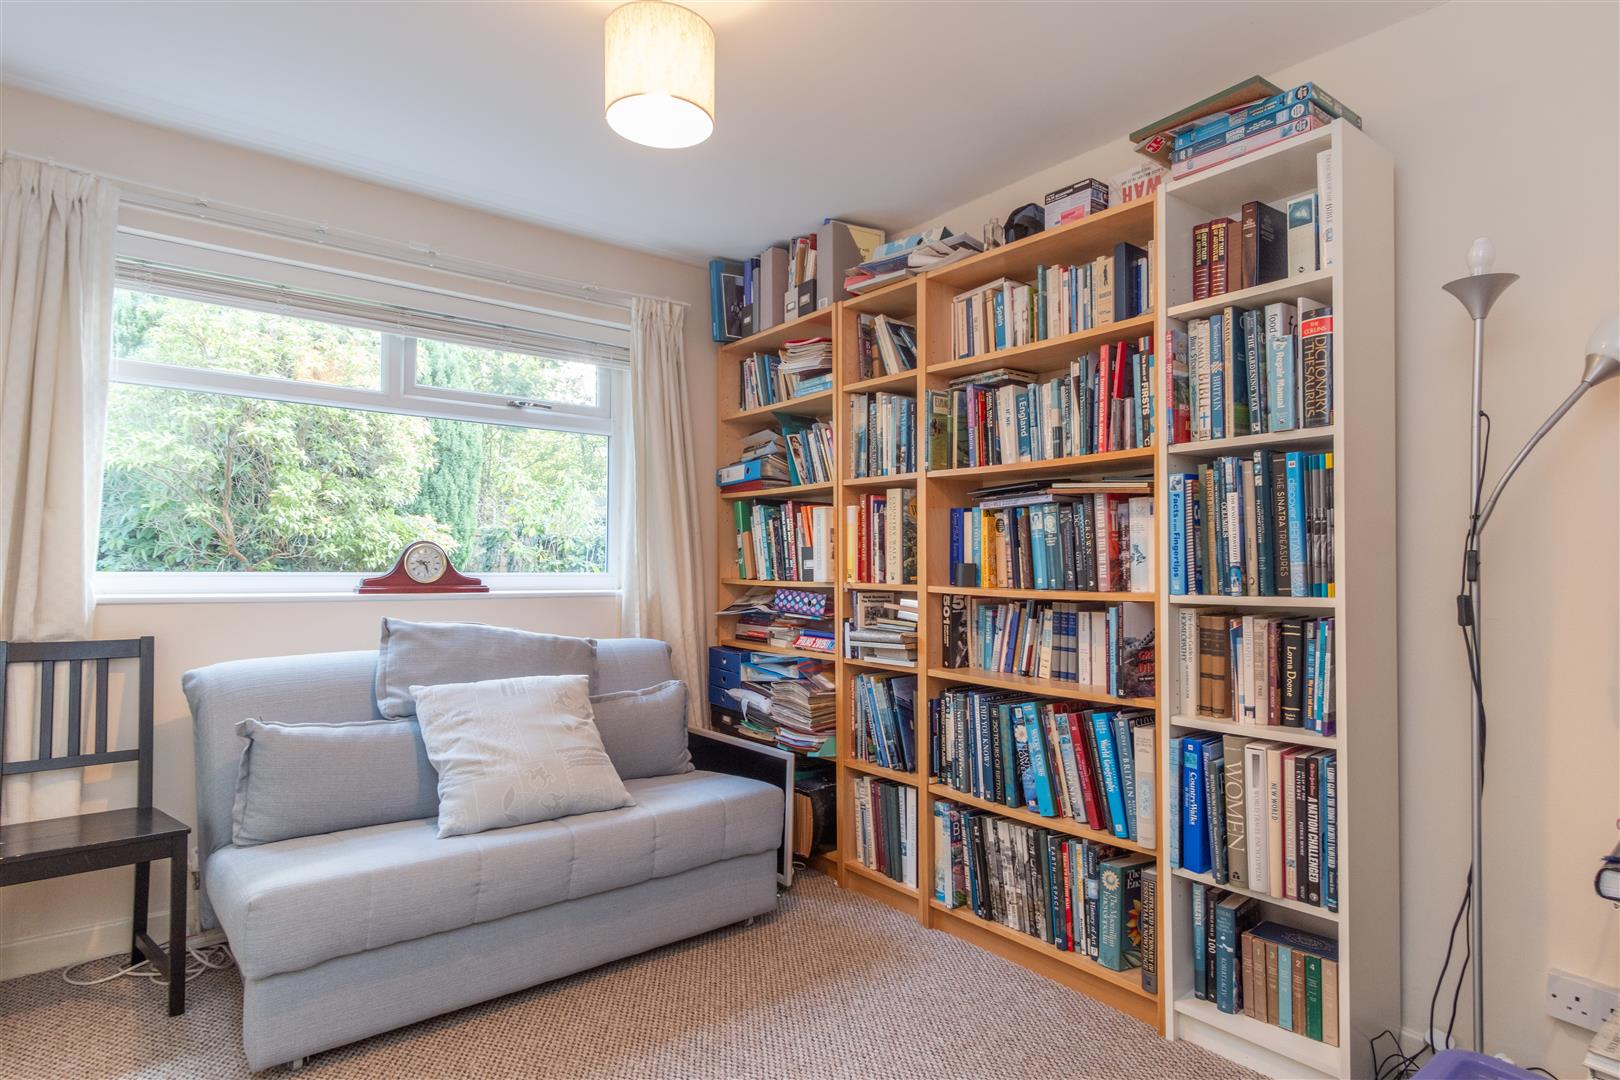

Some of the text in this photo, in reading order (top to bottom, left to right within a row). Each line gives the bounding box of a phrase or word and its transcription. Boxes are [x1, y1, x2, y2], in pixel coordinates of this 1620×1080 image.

[1269, 314, 1278, 333] food
[1304, 325, 1327, 335] COLLINS
[1213, 375, 1221, 411] BRITAIN
[1276, 351, 1285, 408] Repair Manual
[1304, 343, 1314, 417] THESAURUS
[1315, 336, 1328, 414] DICTIONARY
[1019, 400, 1028, 437] England
[1141, 382, 1150, 416] FIRSTS
[1277, 491, 1286, 527] SINATRA
[1288, 478, 1300, 562] discover BRITAIN
[1172, 532, 1180, 577] Fingertips
[1279, 529, 1288, 577] TREASURES
[1287, 646, 1296, 697] Lorna Doone
[1100, 739, 1116, 793] World Geography
[1122, 758, 1134, 798] BRITAIN
[1225, 760, 1245, 852] WOMEN
[1308, 803, 1318, 831] NATION
[1308, 833, 1318, 882] CHALLENGED
